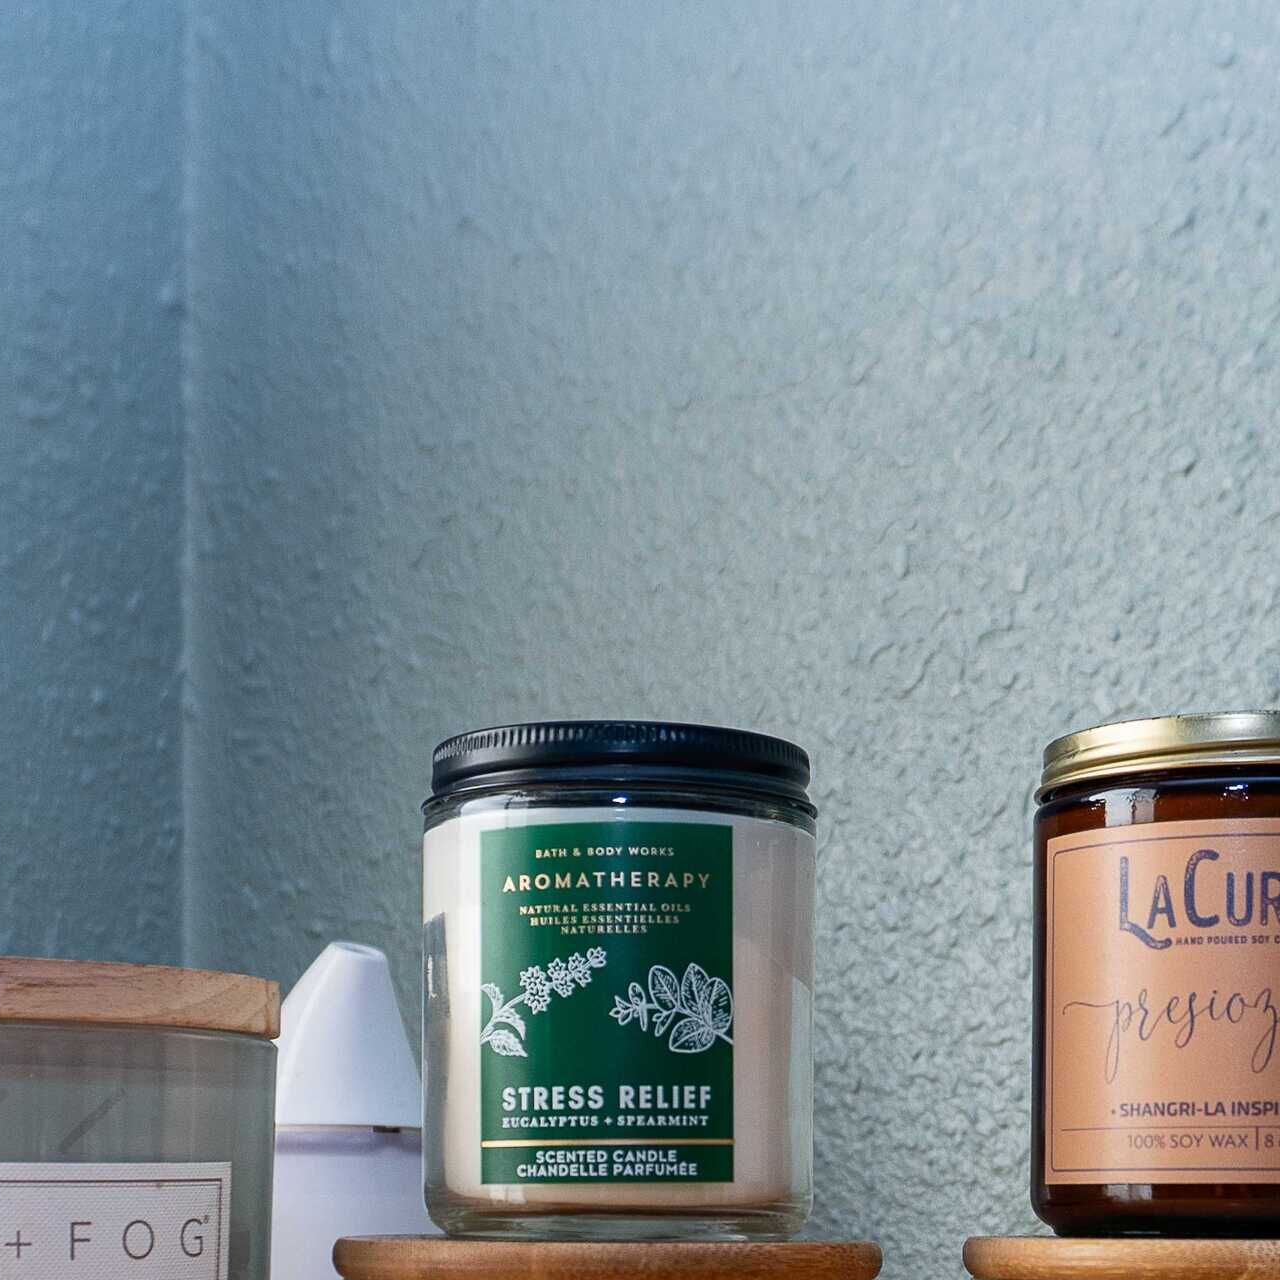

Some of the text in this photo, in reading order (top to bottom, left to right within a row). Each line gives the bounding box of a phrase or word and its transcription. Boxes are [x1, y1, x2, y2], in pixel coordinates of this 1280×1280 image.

[535, 846, 675, 859] BATH & BODY WORKS
[501, 871, 713, 893] AROMATHERAPY
[519, 902, 691, 915] NATURAL ESSENTIAL OILS
[530, 914, 680, 926] HUILES ESSENTIELLES
[560, 924, 647, 935] NATURELLES
[1175, 936, 1203, 946] HAND
[1207, 935, 1249, 945] POURED
[1251, 934, 1270, 944] SOY
[501, 1084, 712, 1112] STRESS RELIEF
[1119, 1101, 1226, 1117] SHANGRI-LA
[501, 1115, 599, 1129] EUCALYPTUS
[616, 1114, 709, 1127] SPEARMINT
[1126, 1133, 1166, 1149] 100%
[1169, 1133, 1204, 1149] SOY
[1208, 1133, 1248, 1149] WAX
[1263, 1133, 1275, 1149] 8
[535, 1149, 677, 1164] SCENTED CANDLE
[516, 1160, 698, 1178] CHANDELLE PARFUMÉE
[4, 1230, 33, 1259] +
